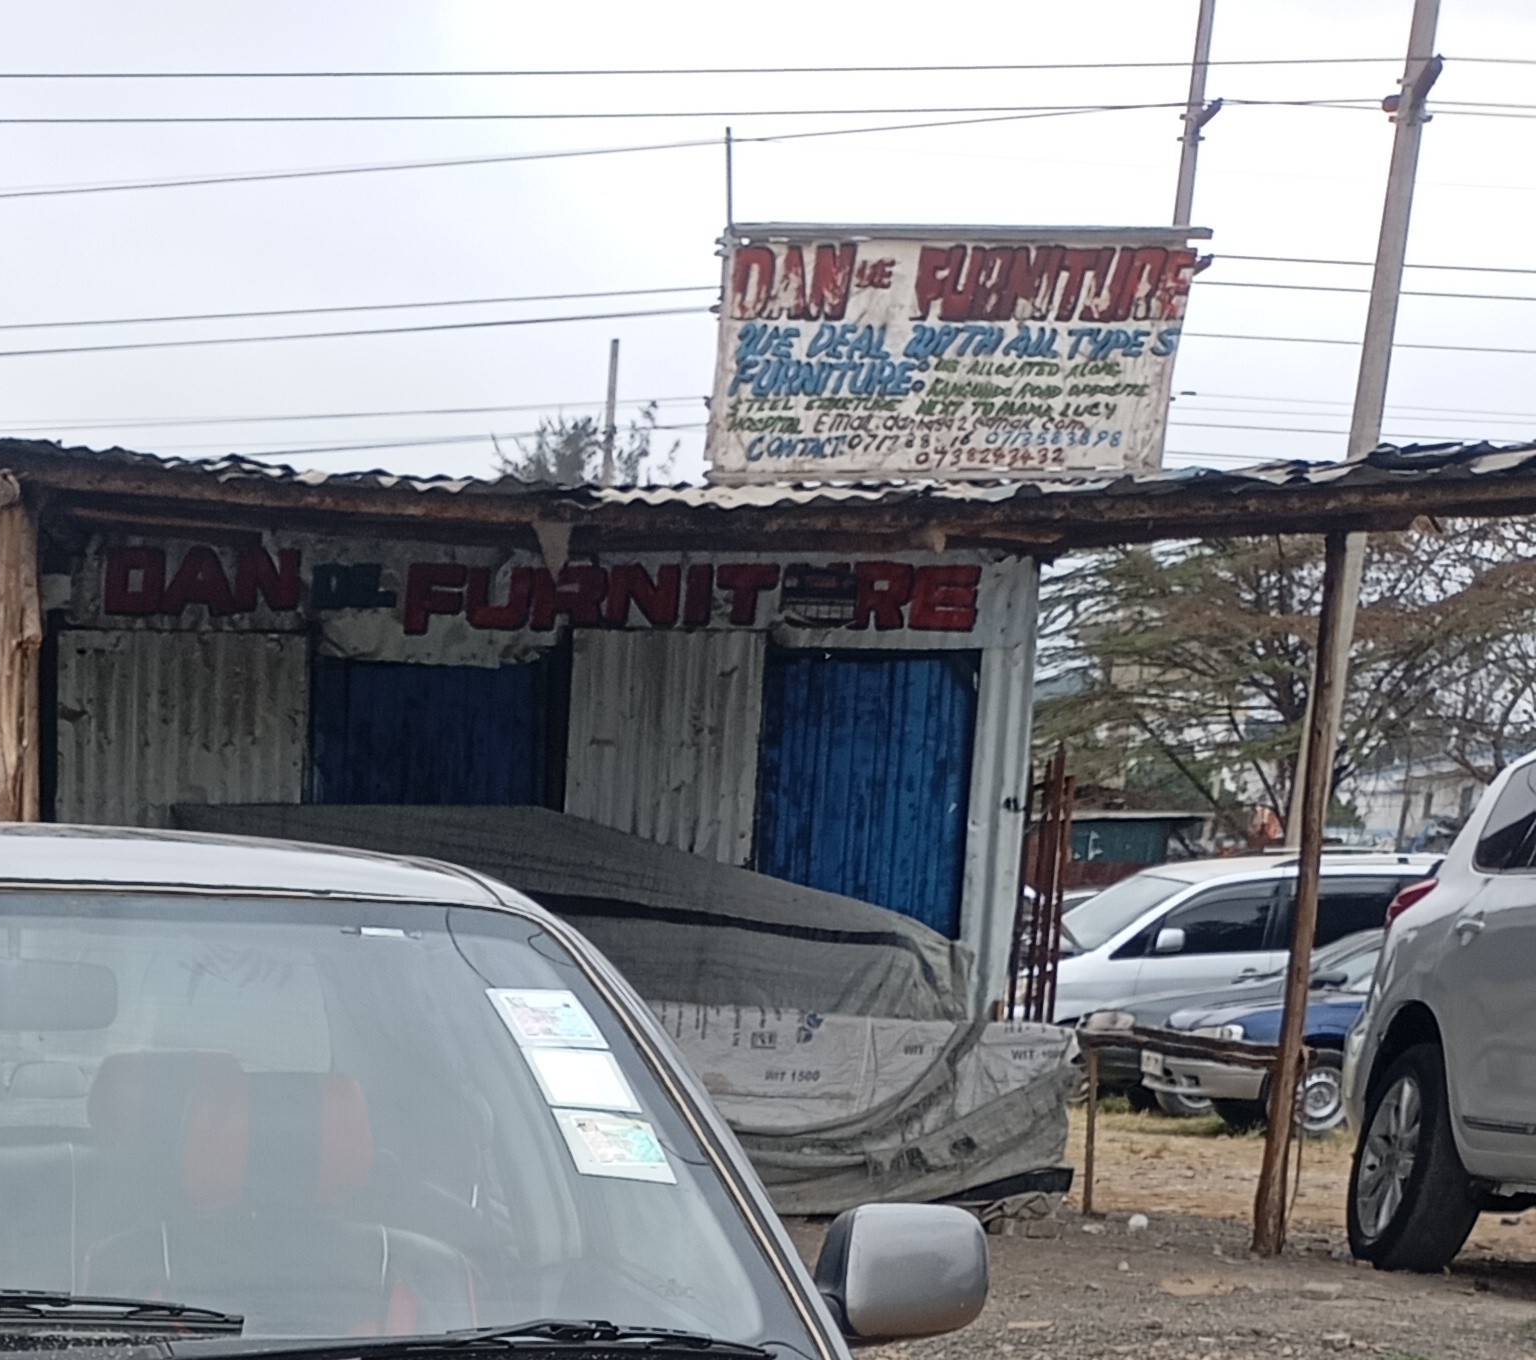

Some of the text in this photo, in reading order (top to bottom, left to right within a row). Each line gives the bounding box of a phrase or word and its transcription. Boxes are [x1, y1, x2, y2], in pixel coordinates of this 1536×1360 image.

[730, 243, 857, 320] DAN
[736, 322, 801, 359] WE
[806, 322, 890, 359] DEAL
[1003, 324, 1060, 359] ALL
[104, 545, 302, 616] DAN
[403, 560, 983, 636] FURNITRE
